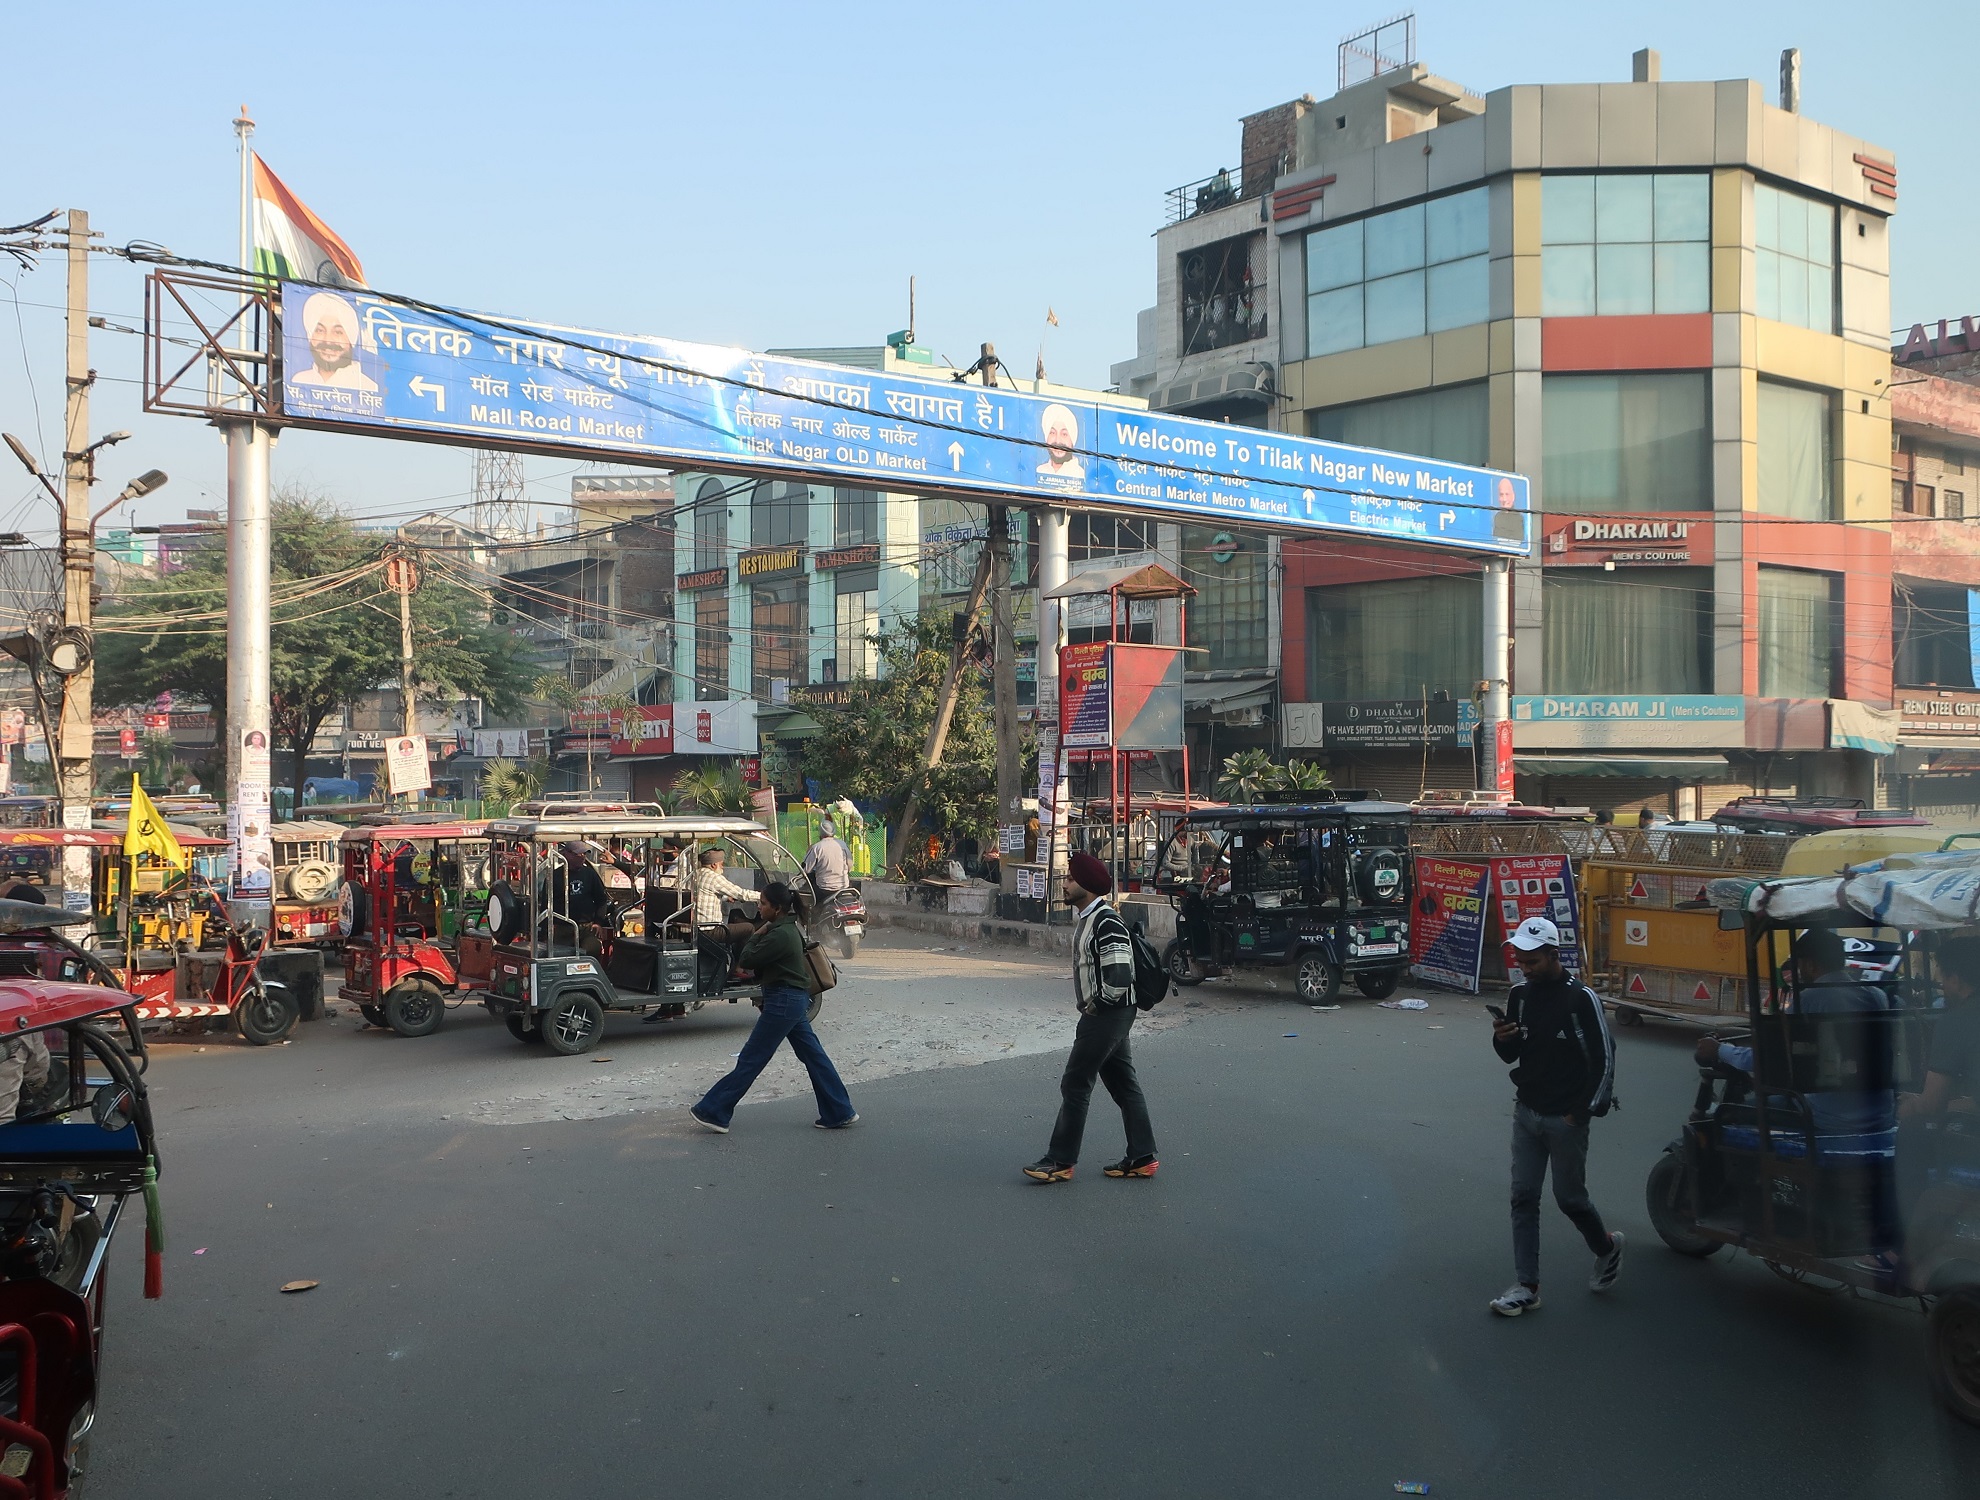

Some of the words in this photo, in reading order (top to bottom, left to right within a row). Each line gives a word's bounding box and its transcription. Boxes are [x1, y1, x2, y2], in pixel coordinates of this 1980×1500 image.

[364, 306, 475, 357] तिलक
[491, 335, 566, 370] नगर
[585, 348, 628, 391] न्यू
[742, 361, 766, 397] में
[885, 389, 964, 424] स्वागत
[311, 387, 352, 404] जरनैल
[358, 390, 383, 409] सिंह
[469, 373, 509, 398] मॉल
[520, 378, 554, 403] रोड
[563, 383, 615, 410] मार्केट
[470, 405, 513, 426] Mall
[520, 406, 572, 432] Road
[578, 417, 645, 440] Market
[736, 405, 782, 430] तिलक
[791, 414, 823, 435] नगर
[832, 417, 871, 442] ओल्ड
[879, 424, 918, 447] मार्केट
[737, 434, 775, 454] Tilak
[782, 441, 829, 462] Nagar
[836, 447, 869, 465] OLD
[875, 451, 927, 471] Market
[1116, 422, 1217, 458] Welcome
[1225, 438, 1250, 463] To
[1256, 444, 1304, 471] Tilak
[1310, 453, 1366, 483] Nagar
[1372, 464, 1411, 488] New
[1416, 471, 1474, 497] Market
[1154, 459, 1187, 480] मार्केट
[1116, 479, 1162, 500] Central
[1166, 486, 1208, 506] Market
[1212, 490, 1246, 509] Metro
[1250, 496, 1288, 515] Market
[1349, 510, 1389, 528] Electric
[1393, 516, 1427, 533] Market
[1575, 520, 1669, 540] DHARAM
[1671, 523, 1687, 538] JI
[925, 530, 942, 543] थोक
[945, 526, 972, 542] विक्रेता
[739, 549, 799, 576] RESTAURANT
[1612, 552, 1641, 561] MEN'S
[1645, 551, 1691, 560] COUTURE
[1082, 667, 1107, 682] बम्ब
[1366, 707, 1412, 717] DHARAM
[1543, 699, 1639, 717] DHARAM
[1646, 701, 1665, 717] JI
[1671, 706, 1700, 718] (Men's
[1701, 706, 1739, 718] Couture)
[1903, 700, 1928, 715] RENU
[1930, 701, 1954, 716] STEEL
[698, 719, 710, 728] MINI
[1290, 707, 1323, 746] 50
[1326, 726, 1336, 735] WE
[1337, 726, 1355, 735] HAVE
[1356, 725, 1382, 735] SHIFTED
[1384, 725, 1393, 734] TO
[1395, 725, 1400, 734] A
[1402, 725, 1417, 734] NEW
[1421, 725, 1455, 734] LOCATION
[1623, 723, 1684, 732] TAILORING
[347, 740, 368, 748] FOOT
[358, 732, 379, 741] RAJ
[1611, 734, 1662, 744] Selection
[1434, 864, 1456, 875] दिल्ली
[1458, 868, 1481, 879] पुलिस
[1512, 859, 1536, 869] दिल्ली
[1538, 858, 1562, 871] पुलिस
[1443, 893, 1482, 914] बम्ब
[1451, 913, 1473, 923] सकता
[1473, 915, 1480, 924] है
